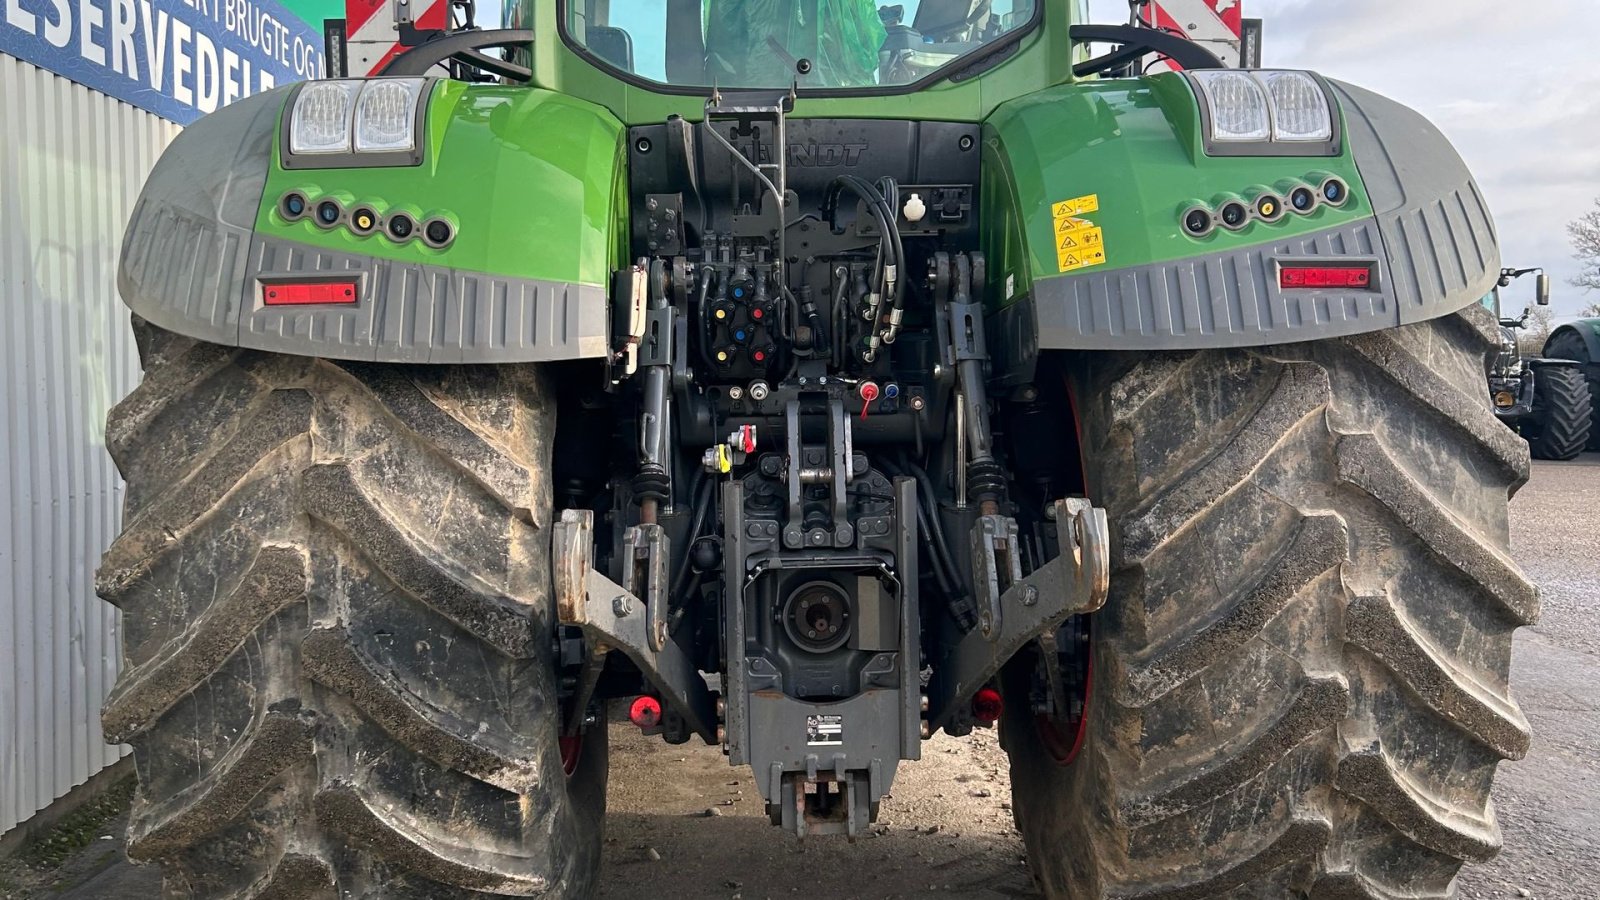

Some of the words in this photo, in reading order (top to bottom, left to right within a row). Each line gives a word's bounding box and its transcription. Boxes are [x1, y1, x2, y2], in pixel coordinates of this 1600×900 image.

[6, 0, 276, 114] SERVEDE
[225, 0, 290, 68] BRUGTE
[293, 36, 315, 80] OG
[743, 143, 868, 167] NDT
